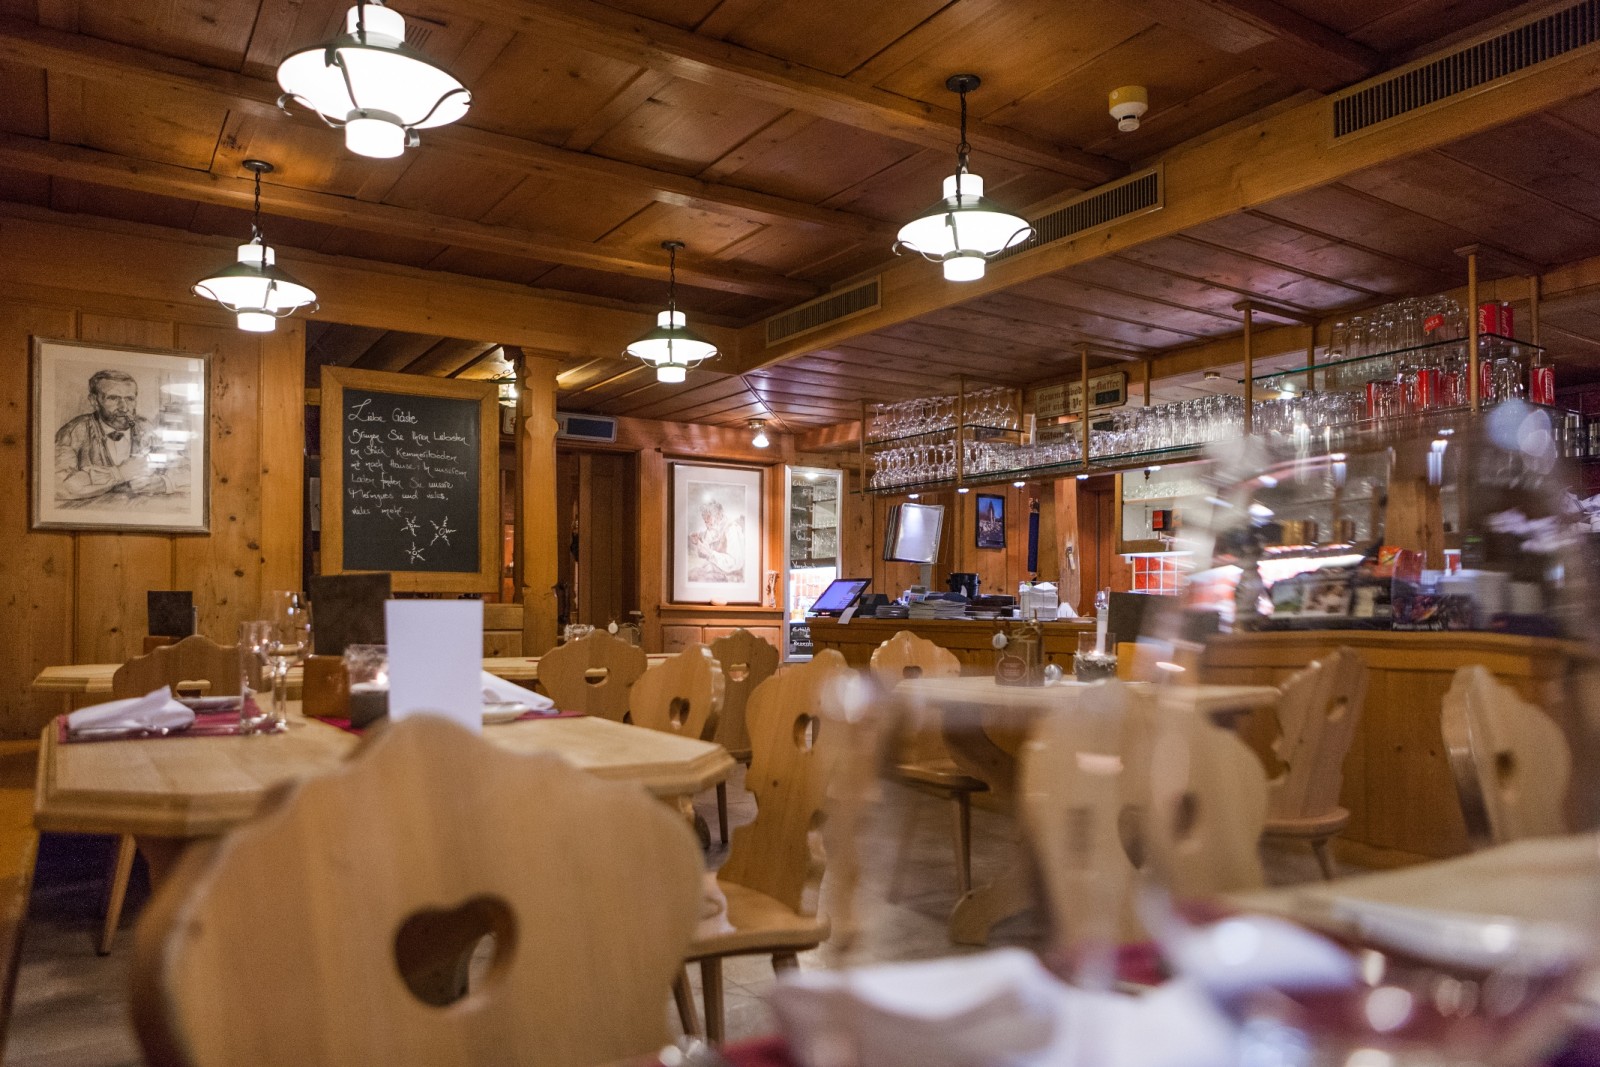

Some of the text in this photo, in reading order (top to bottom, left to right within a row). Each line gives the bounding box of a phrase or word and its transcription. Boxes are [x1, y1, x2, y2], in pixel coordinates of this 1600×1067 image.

[348, 399, 419, 424] Liebe Gäste
[348, 429, 470, 447] Bringen Sie Ihren Liebsten
[351, 473, 377, 488] Laden
[380, 471, 404, 490] finden
[410, 476, 427, 489] Sie
[402, 490, 419, 499] und
